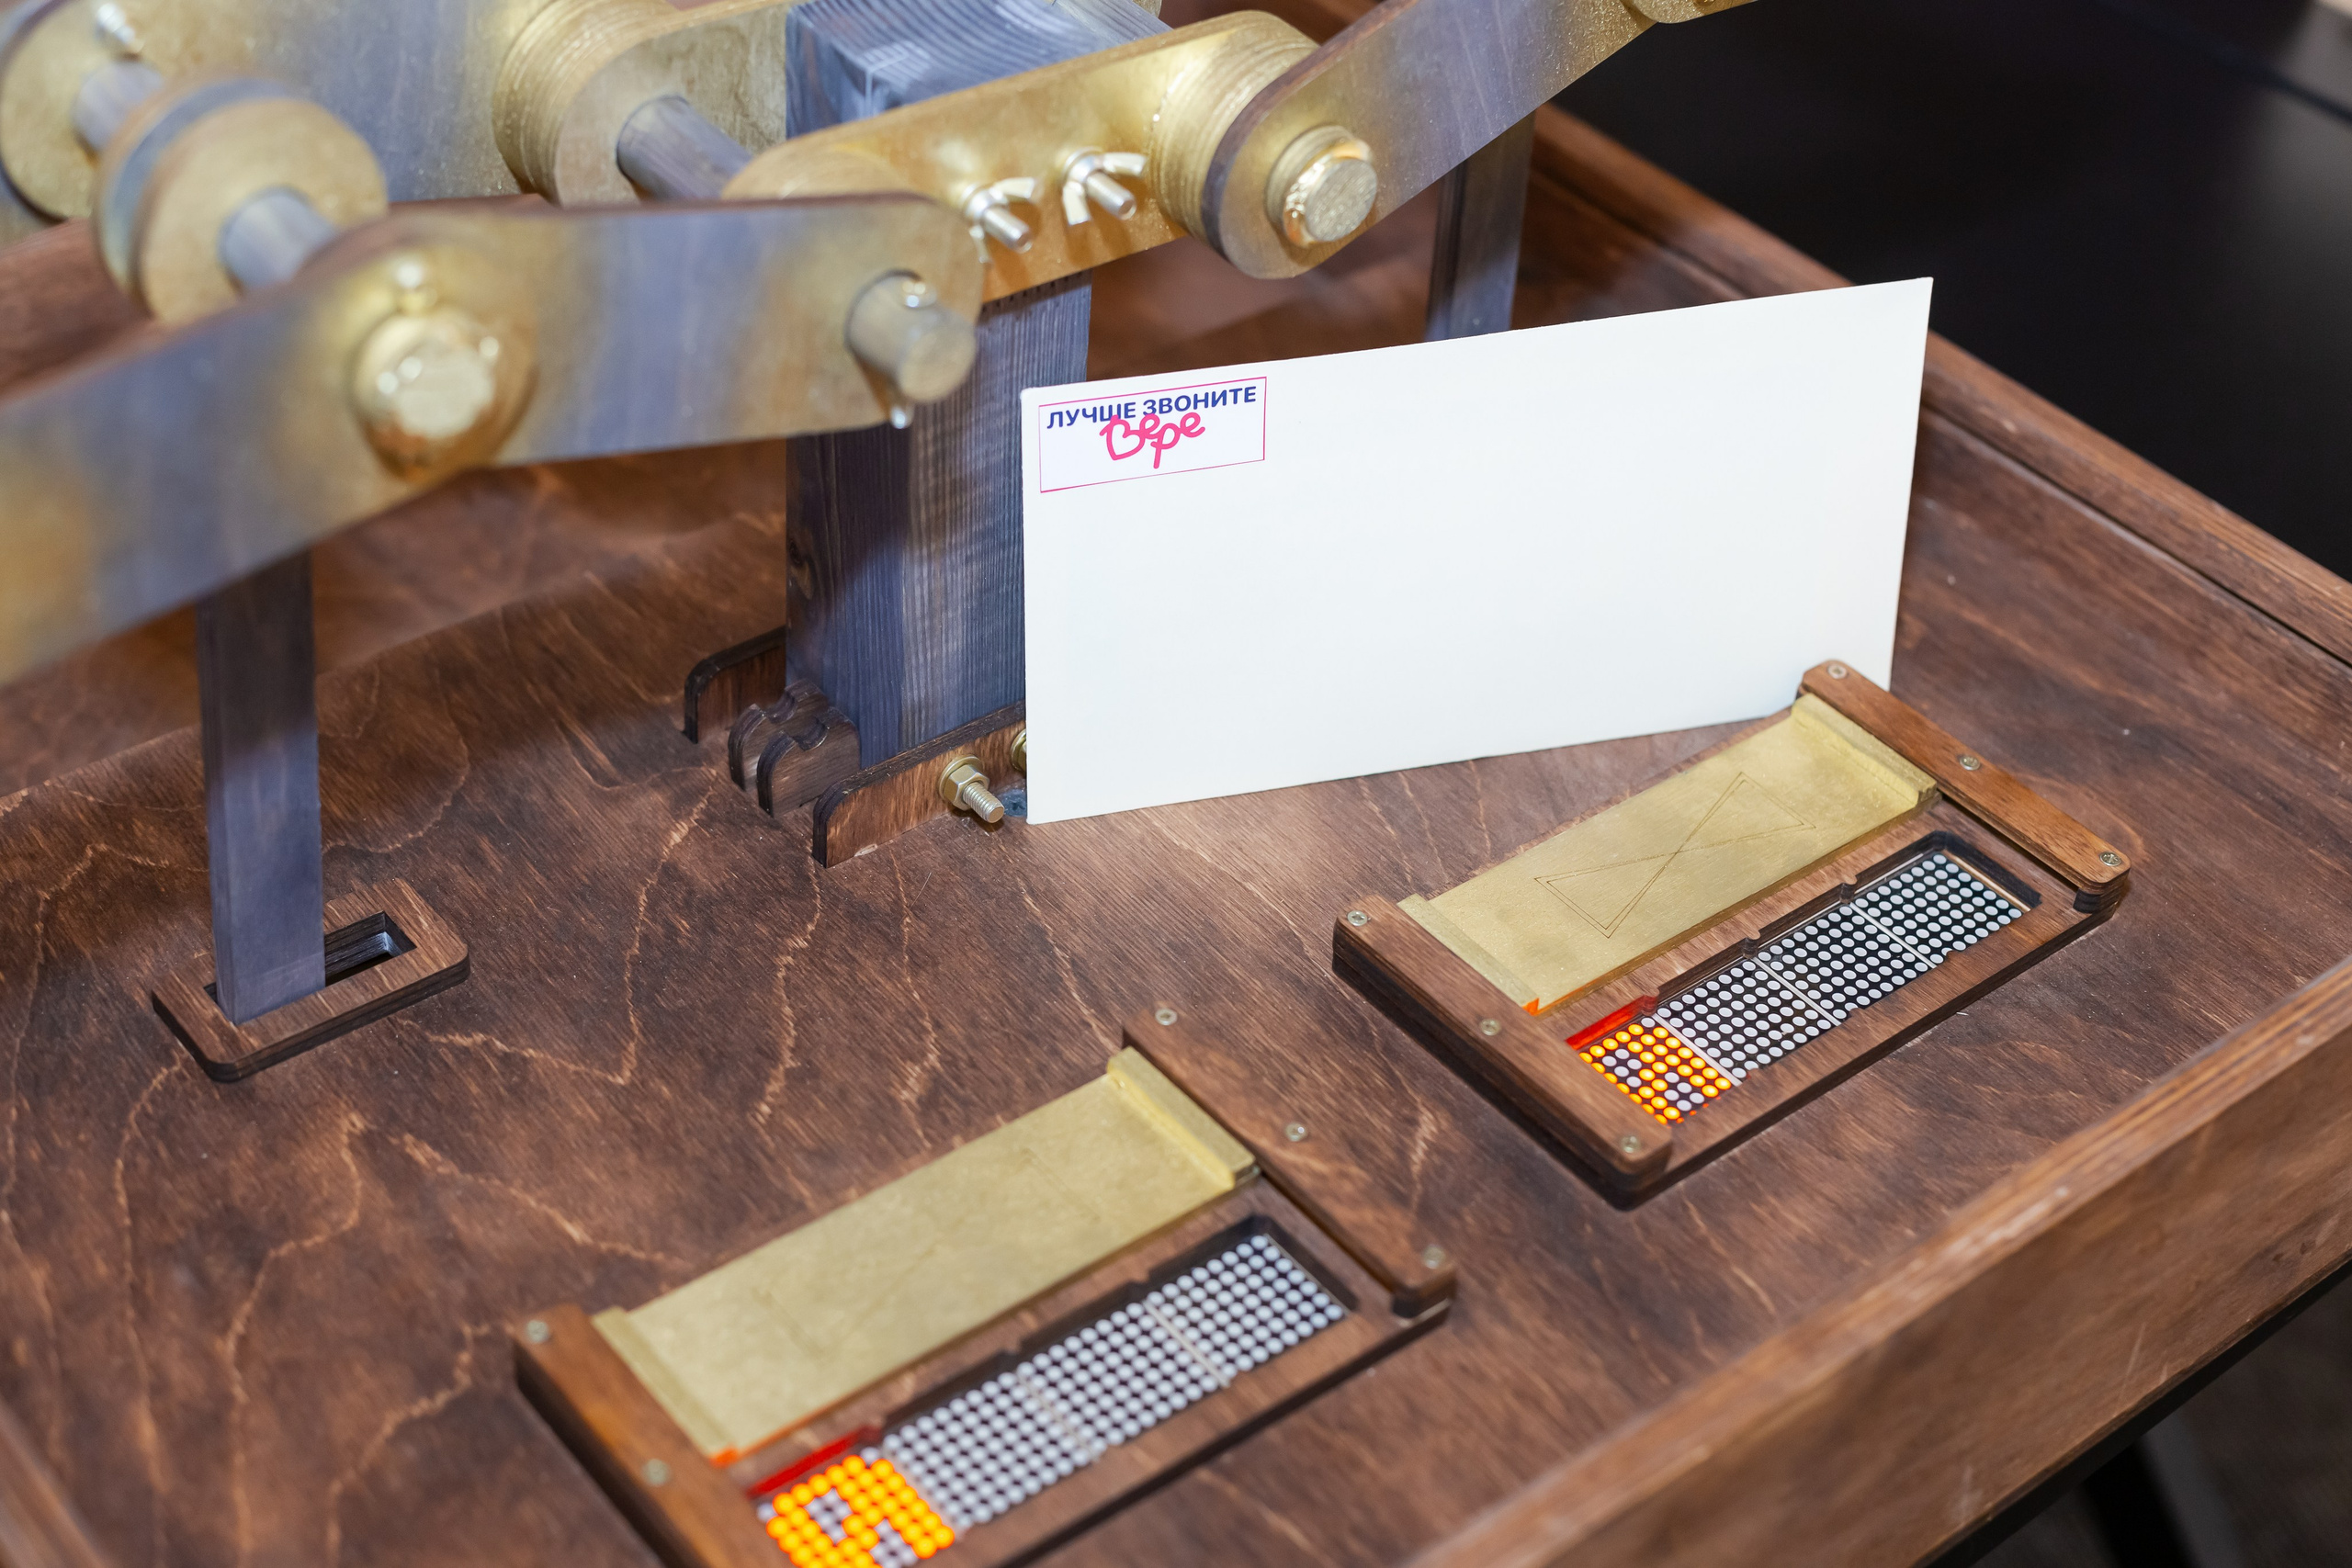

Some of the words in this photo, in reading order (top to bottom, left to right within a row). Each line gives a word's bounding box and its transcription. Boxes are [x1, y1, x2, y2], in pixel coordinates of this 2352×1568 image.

[1046, 401, 1136, 429] ЛУЧШЕ
[1142, 386, 1257, 416] ЗВОНИТЕ
[1099, 412, 1206, 469] Вере
